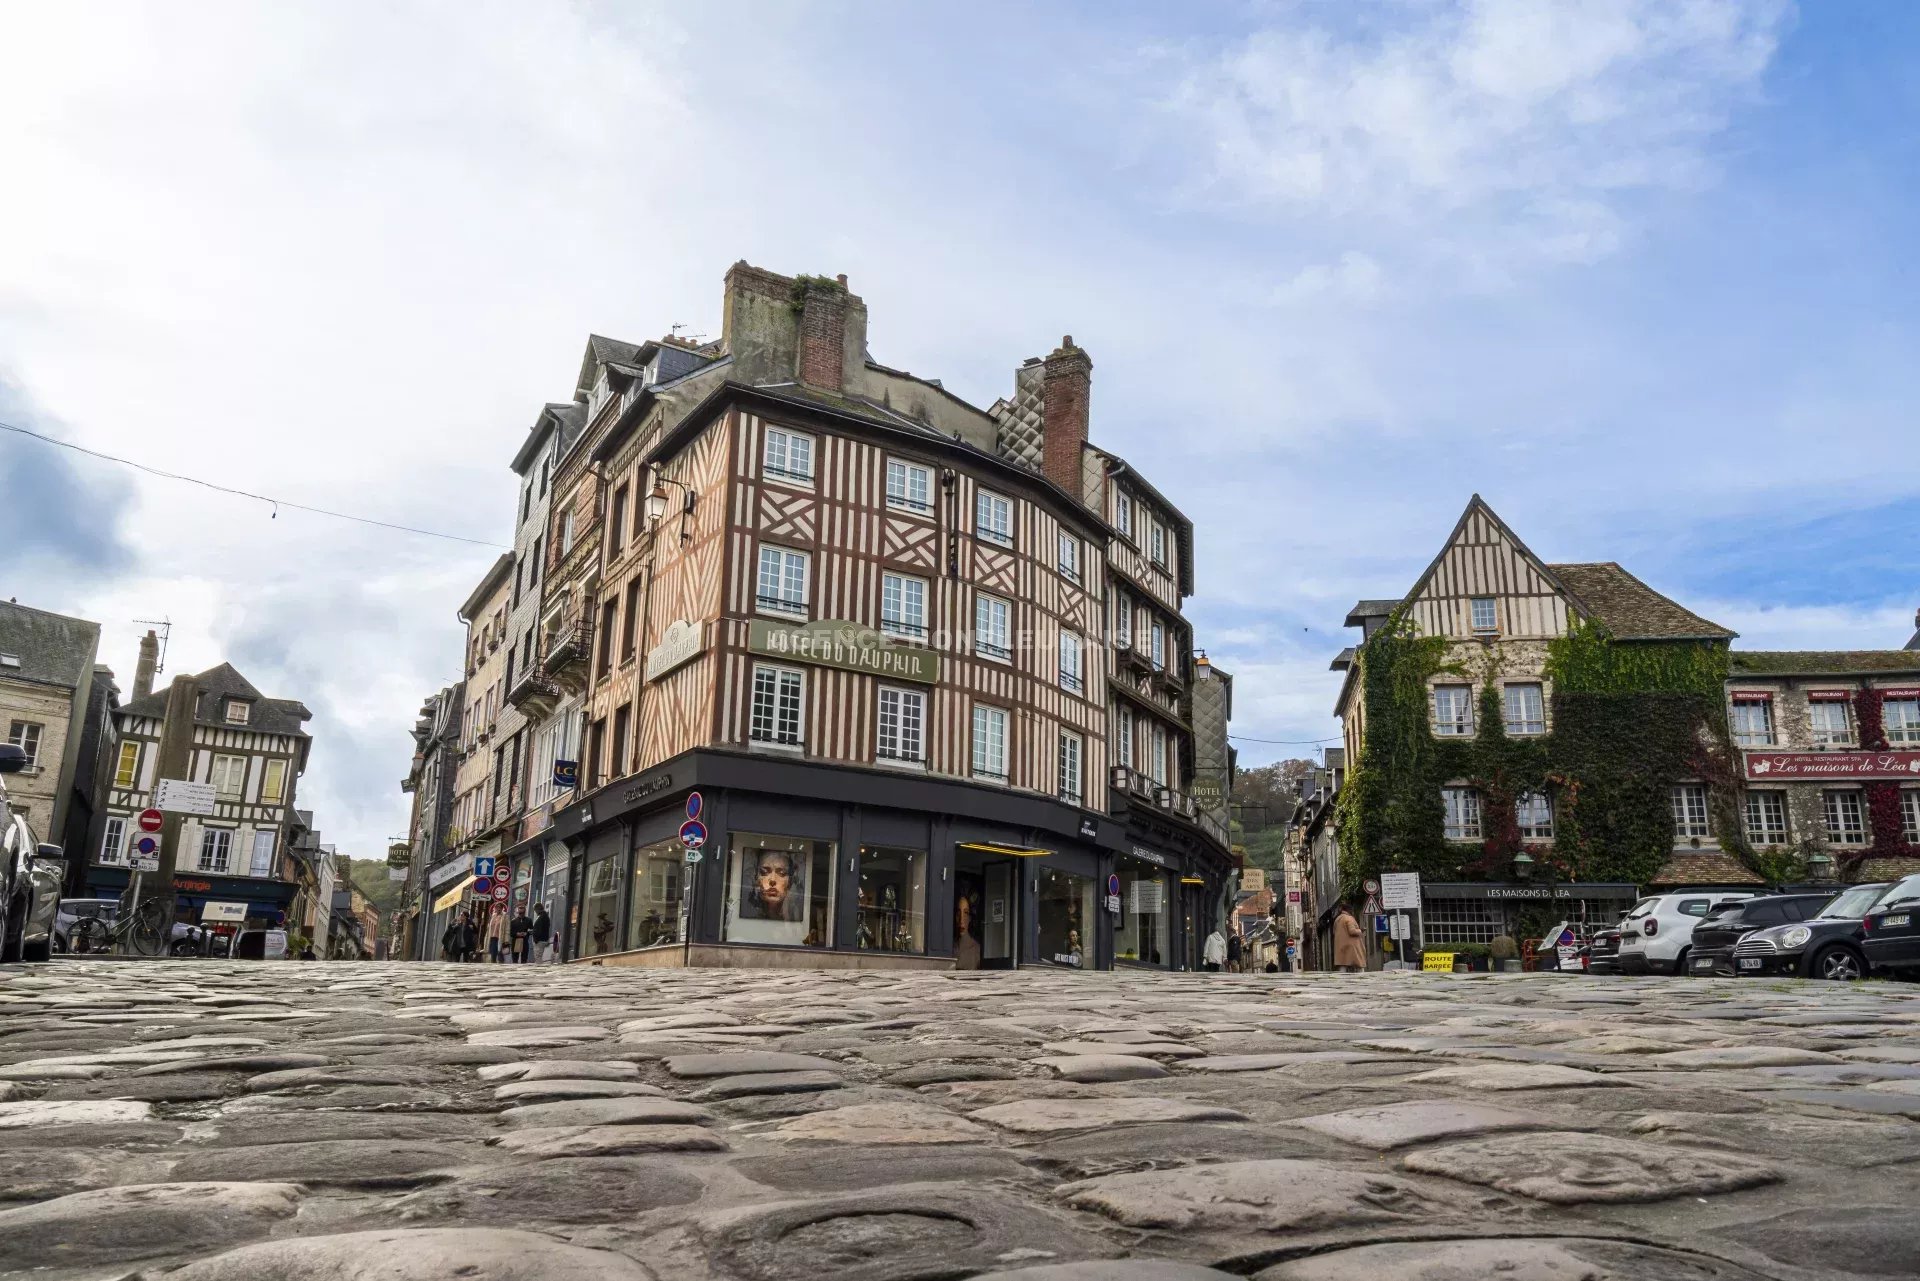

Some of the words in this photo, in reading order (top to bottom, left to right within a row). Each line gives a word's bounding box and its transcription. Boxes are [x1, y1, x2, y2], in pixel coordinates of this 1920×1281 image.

[766, 630, 817, 659] HÔTEL
[823, 641, 843, 663] DU
[850, 646, 923, 675] DAUPHIN
[1773, 757, 1798, 772] Les
[1803, 762, 1854, 772] maisons
[1858, 759, 1874, 772] de
[1876, 755, 1908, 772] Léa
[1194, 786, 1222, 796] HOTEL
[1487, 889, 1500, 897] LES
[1502, 889, 1541, 897] MAISONS
